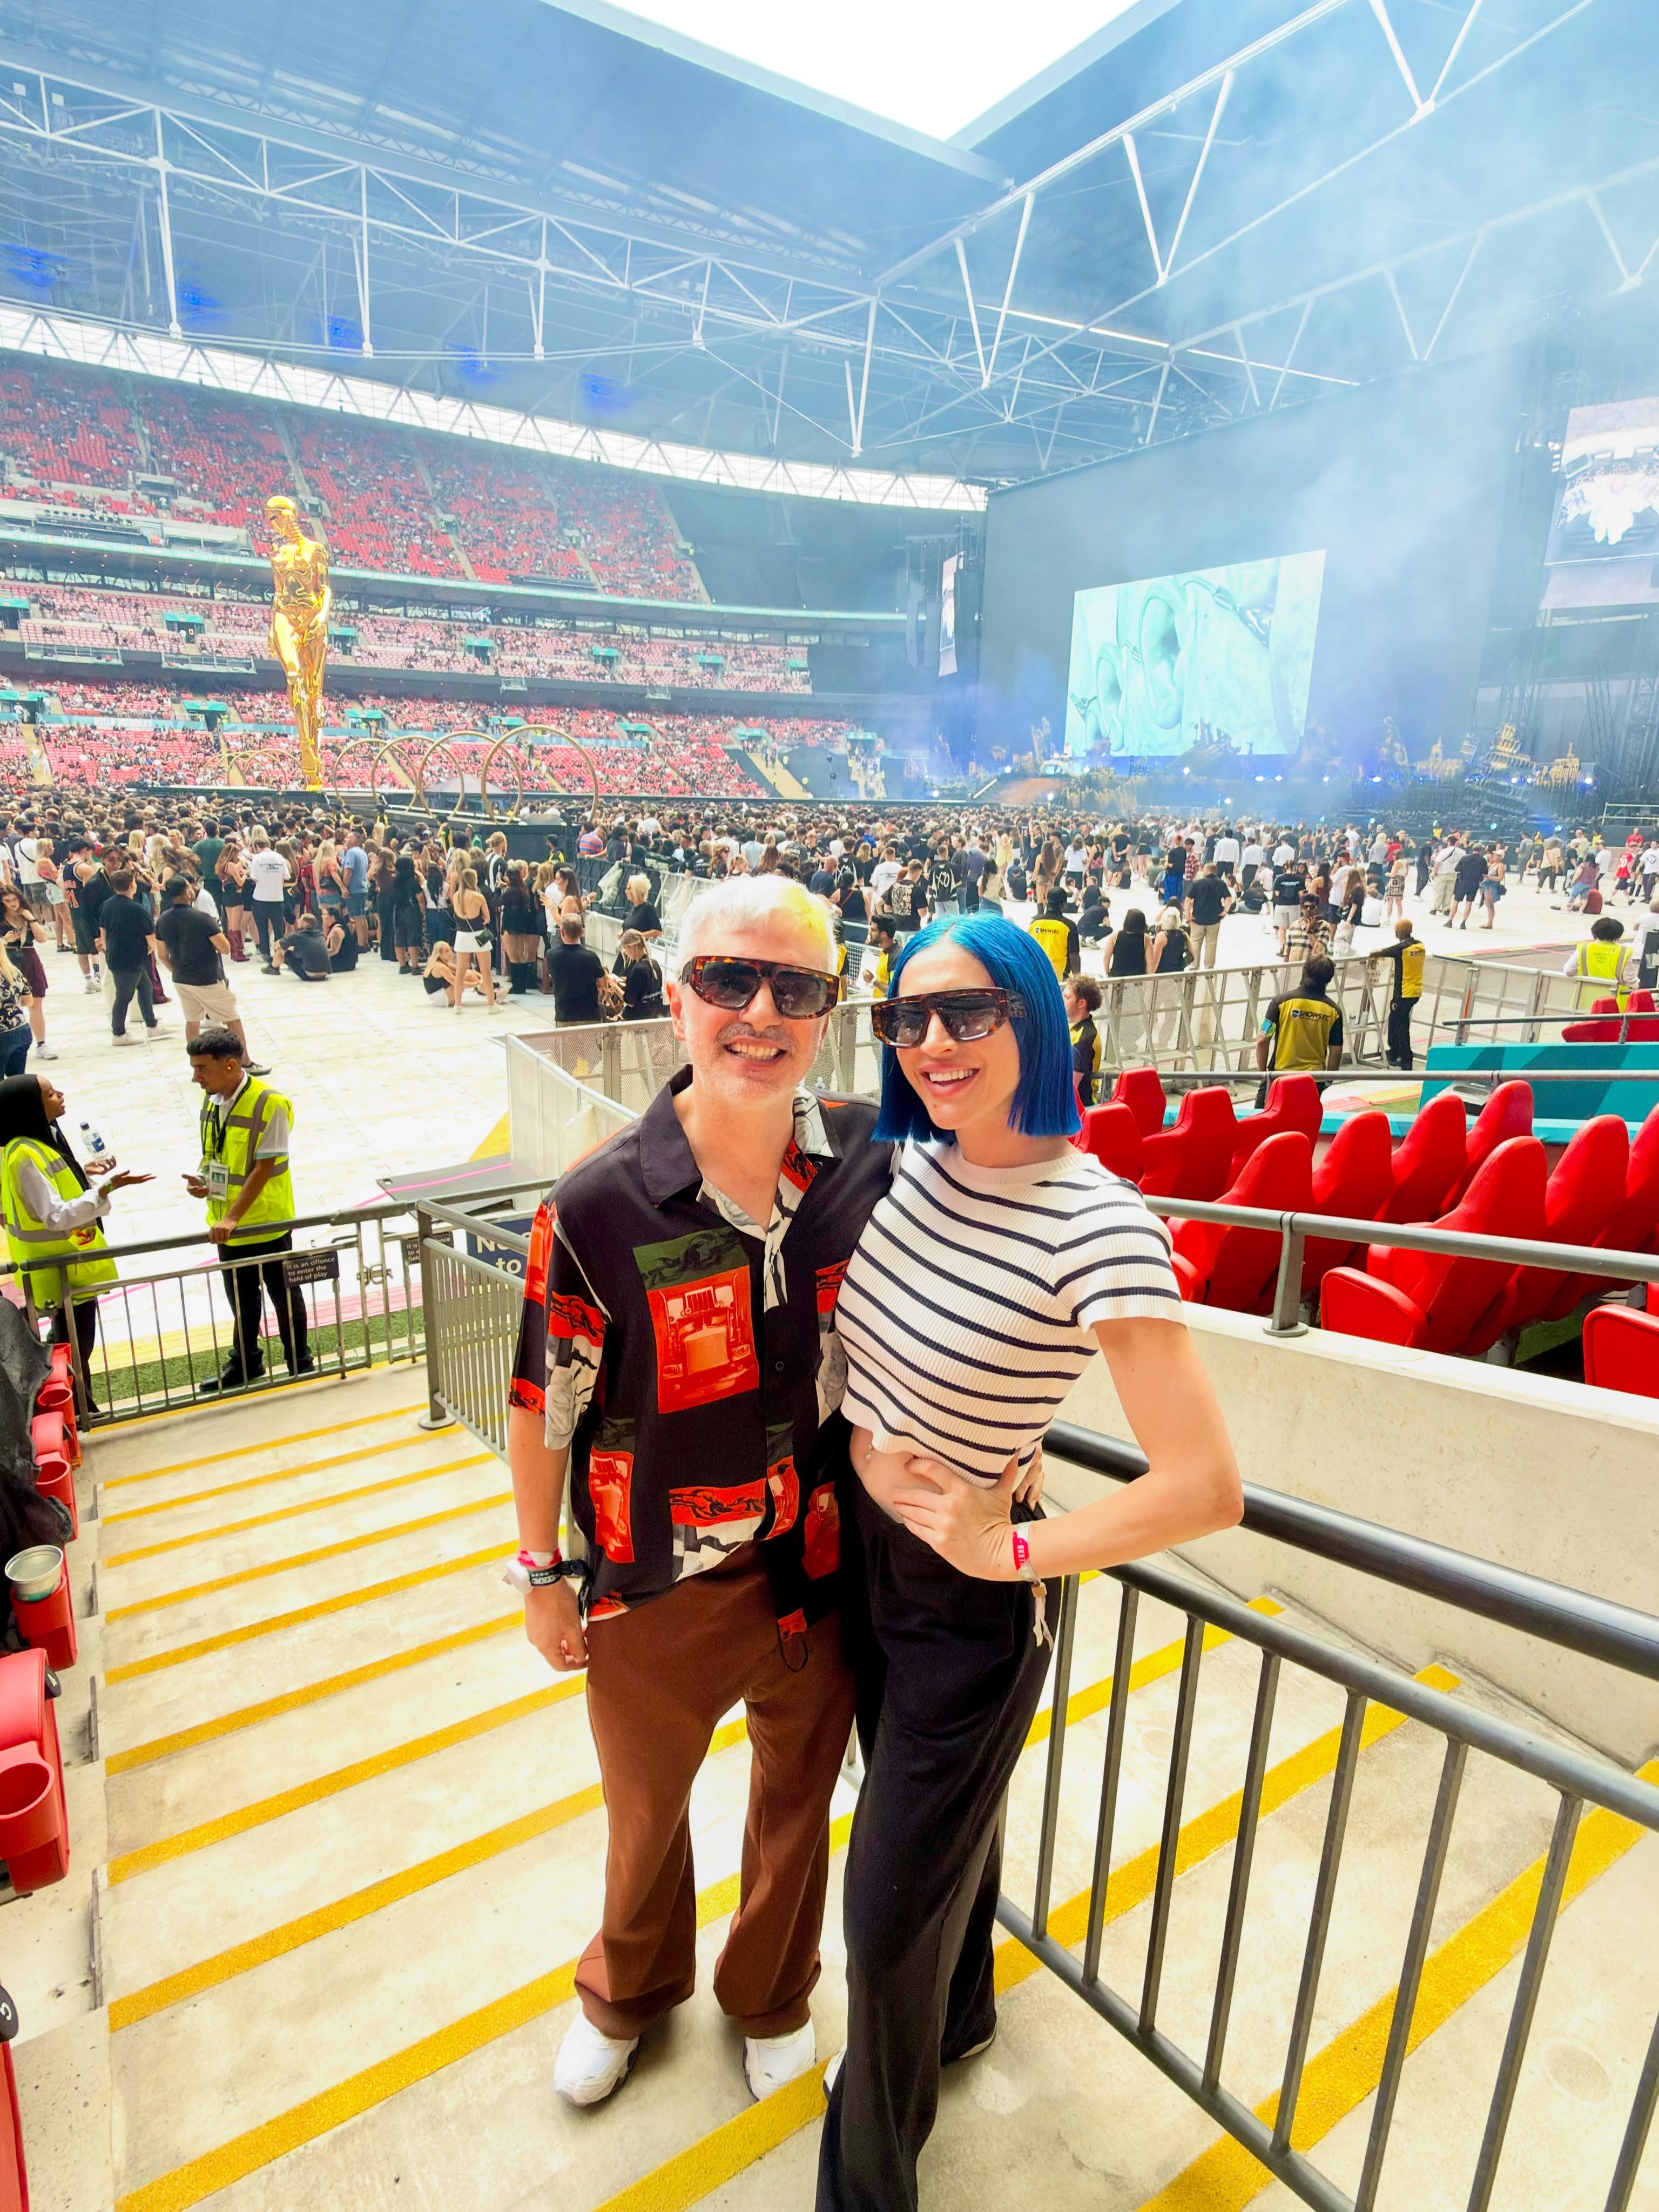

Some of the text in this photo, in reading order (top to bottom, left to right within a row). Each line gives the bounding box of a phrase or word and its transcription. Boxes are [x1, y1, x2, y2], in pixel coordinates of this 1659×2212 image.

[1300, 1010, 1330, 1021] SHOWSEC
[311, 1257, 335, 1265] offence
[496, 1258, 522, 1274] to
